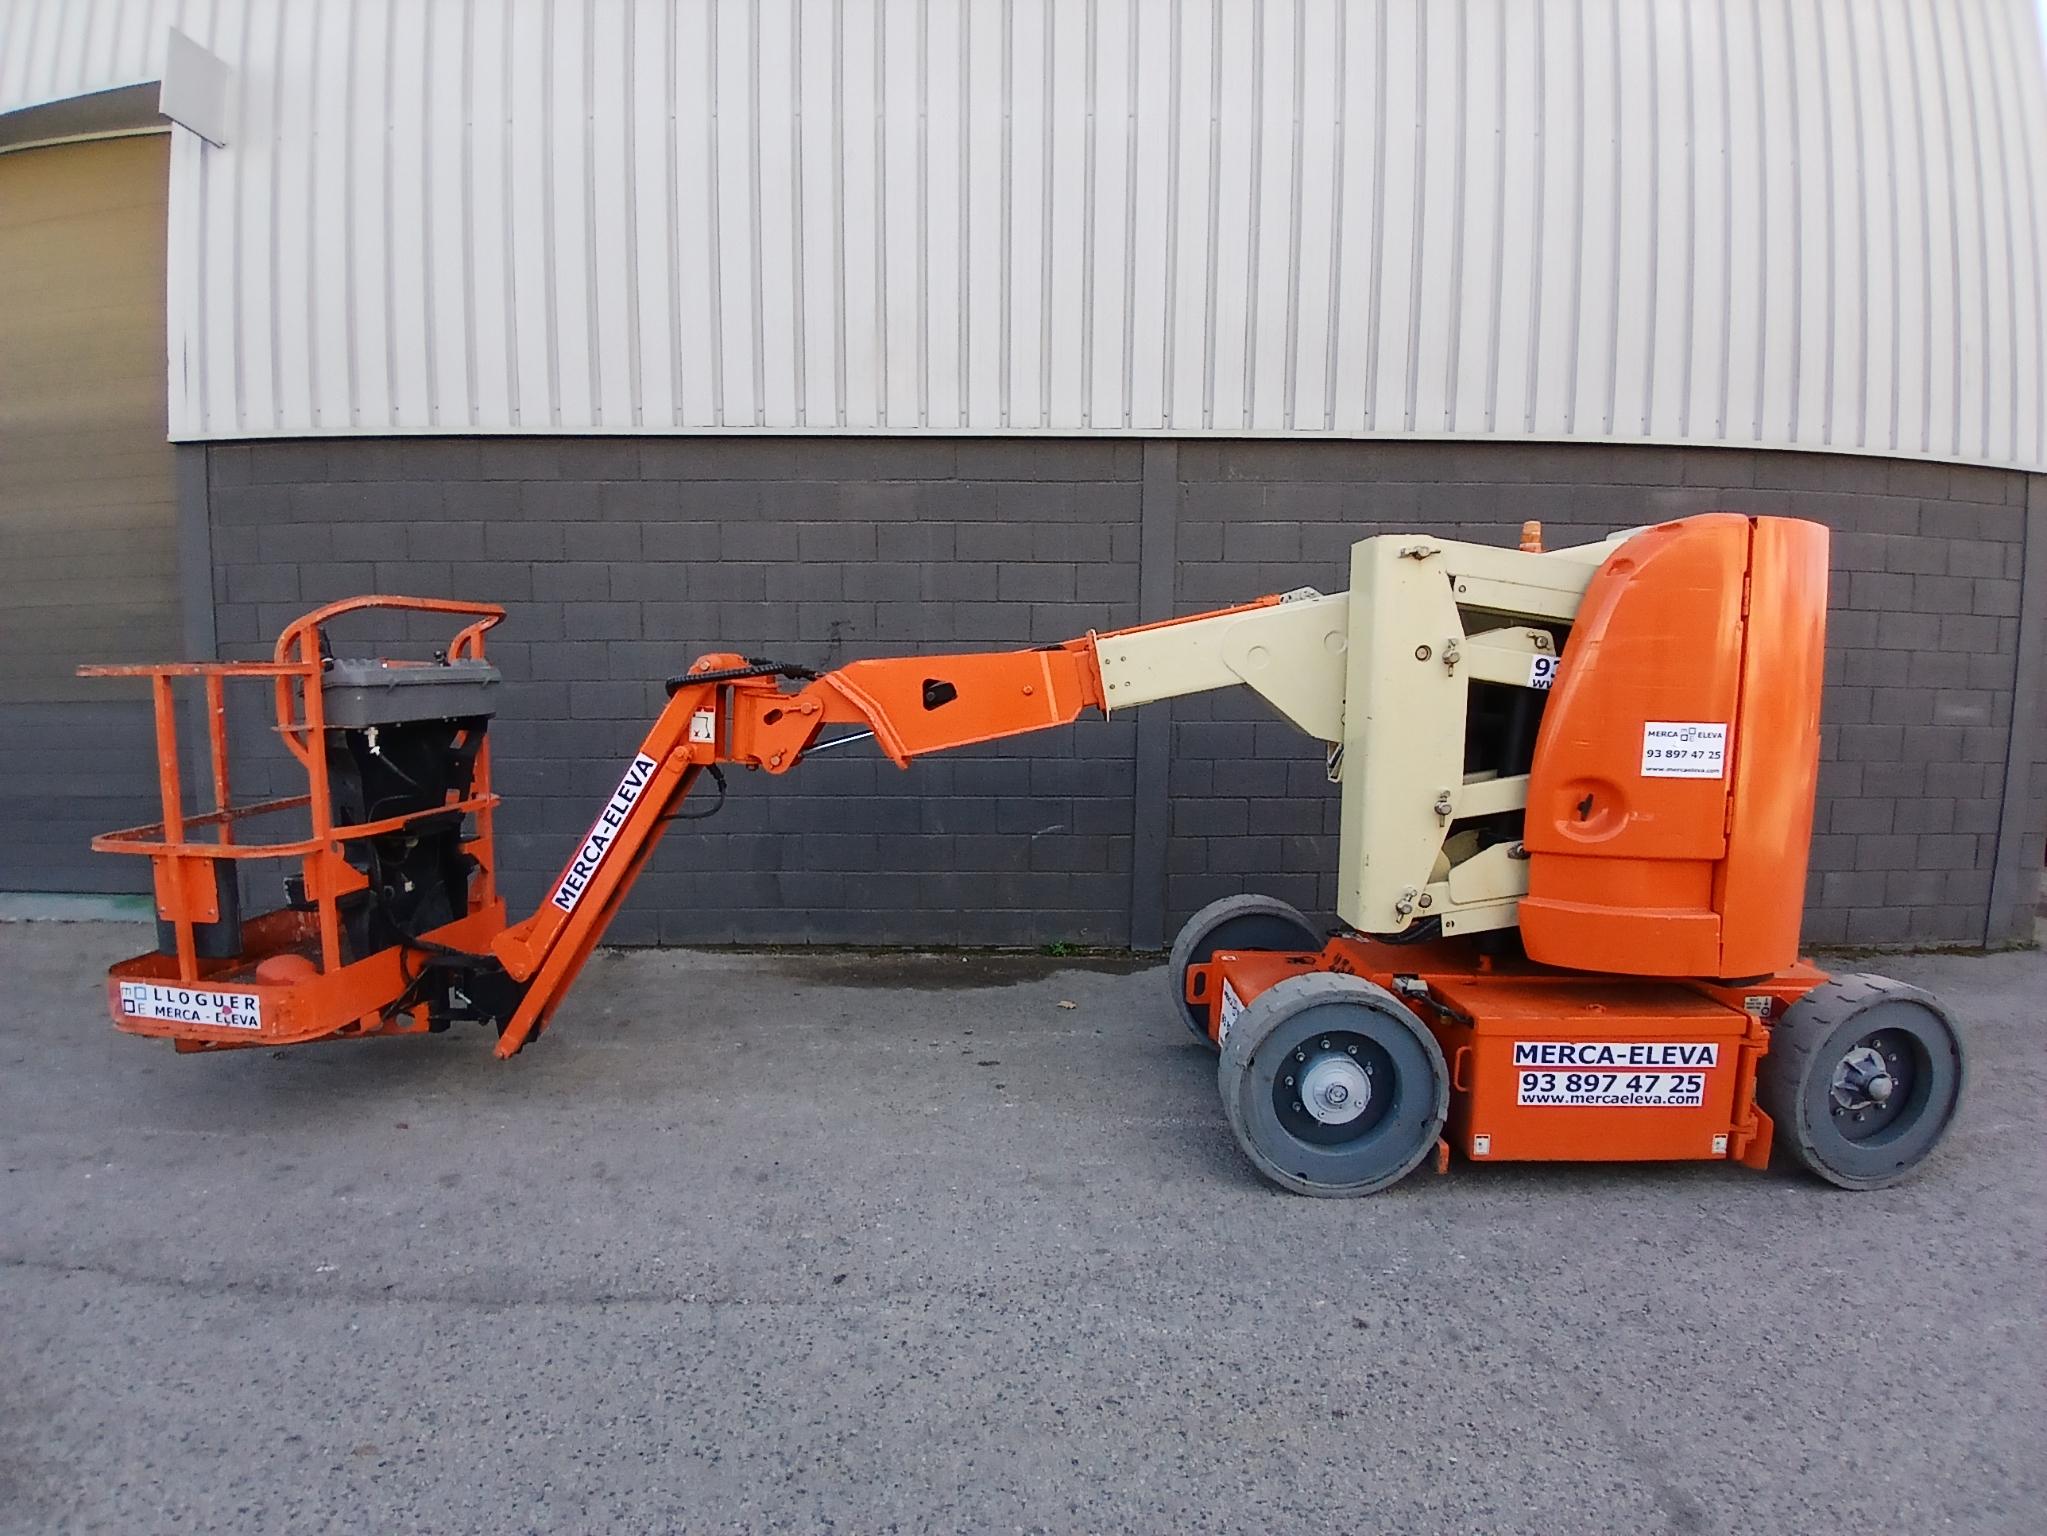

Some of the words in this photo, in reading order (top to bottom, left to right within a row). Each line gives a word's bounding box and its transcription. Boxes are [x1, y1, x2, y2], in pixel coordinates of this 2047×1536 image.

[1648, 730, 1678, 738] MERCA
[1697, 731, 1722, 739] ELEVA
[1646, 749, 1662, 758] 93
[1665, 749, 1688, 759] 897
[1691, 750, 1705, 759] 47
[1708, 751, 1721, 760] 25
[555, 758, 655, 910] MERCA-ELEVA
[154, 987, 256, 1011] LLOGUER
[155, 1006, 201, 1021] MERCA
[1515, 1045, 1714, 1065] MERCA-ELEVA
[1522, 1073, 1556, 1092] 93
[1565, 1074, 1618, 1093] 897
[1626, 1075, 1660, 1093] 47
[1668, 1075, 1701, 1093] 25
[1521, 1093, 1700, 1106] www.mercaeleva.com
